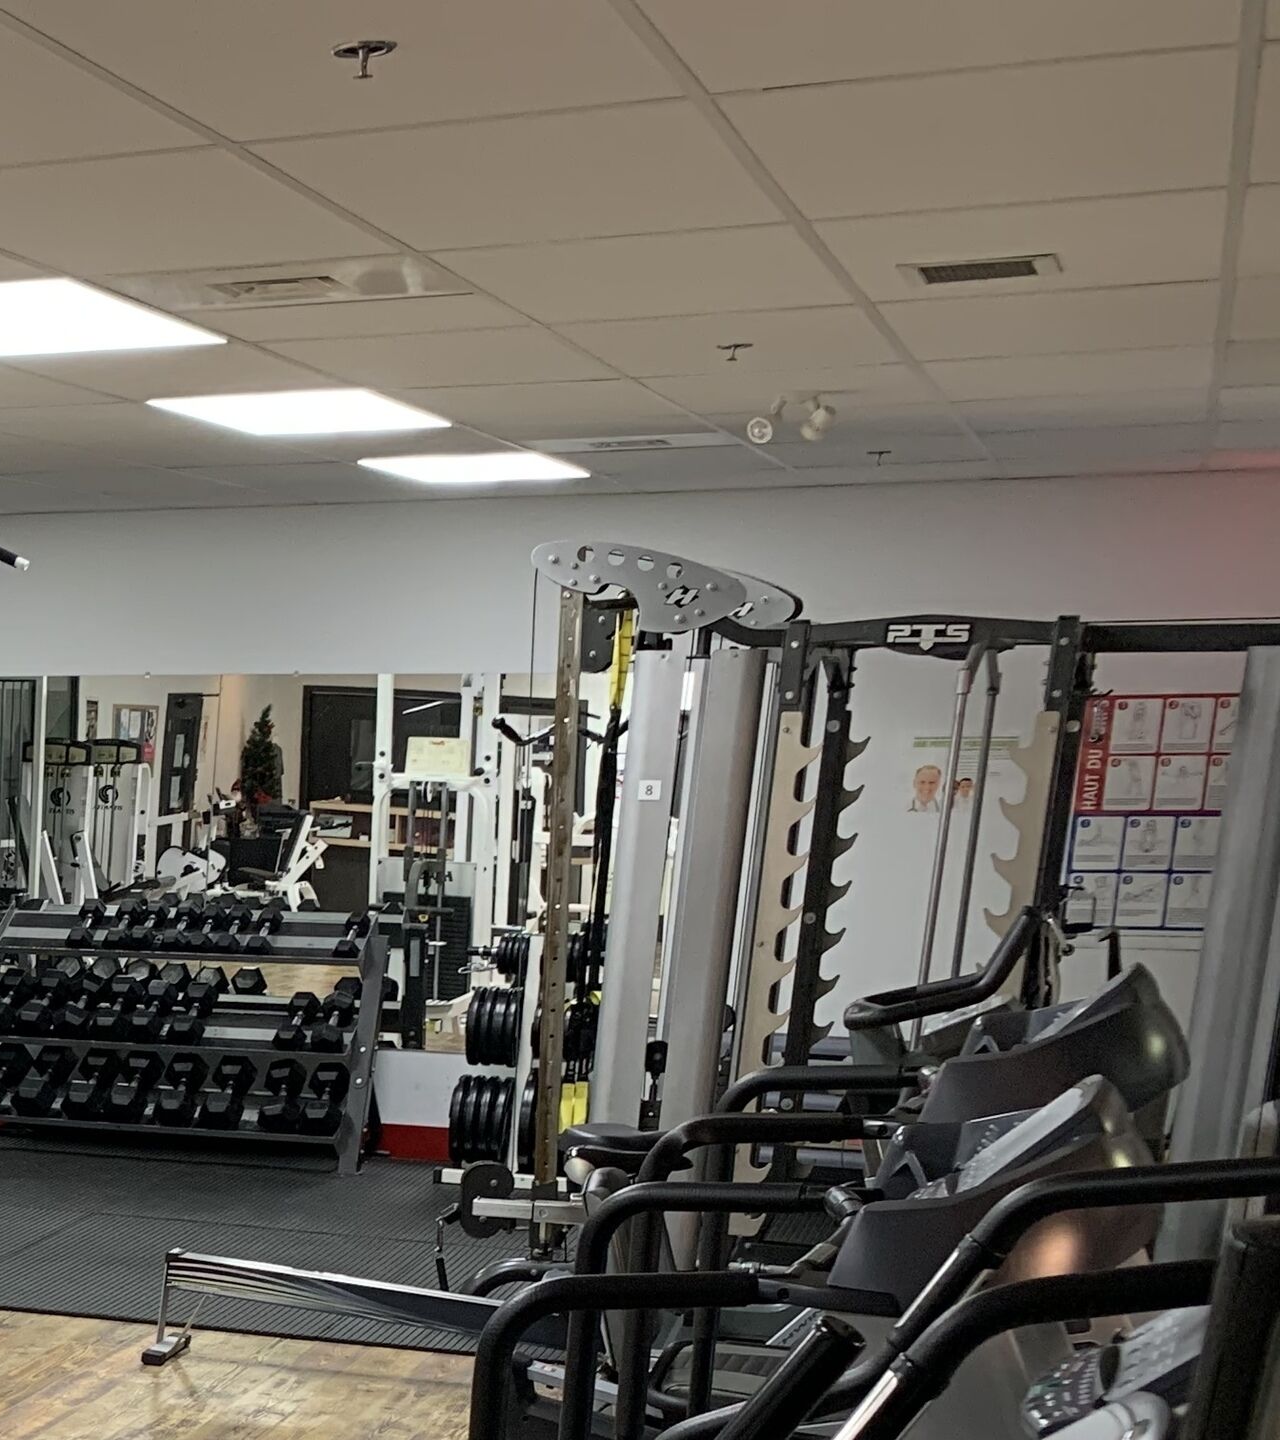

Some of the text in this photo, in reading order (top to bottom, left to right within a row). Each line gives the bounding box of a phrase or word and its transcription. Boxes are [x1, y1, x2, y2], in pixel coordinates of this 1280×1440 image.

[887, 624, 971, 651] PTS
[1087, 748, 1103, 770] DU
[645, 784, 653, 796] 8
[1081, 774, 1102, 811] HAUT
